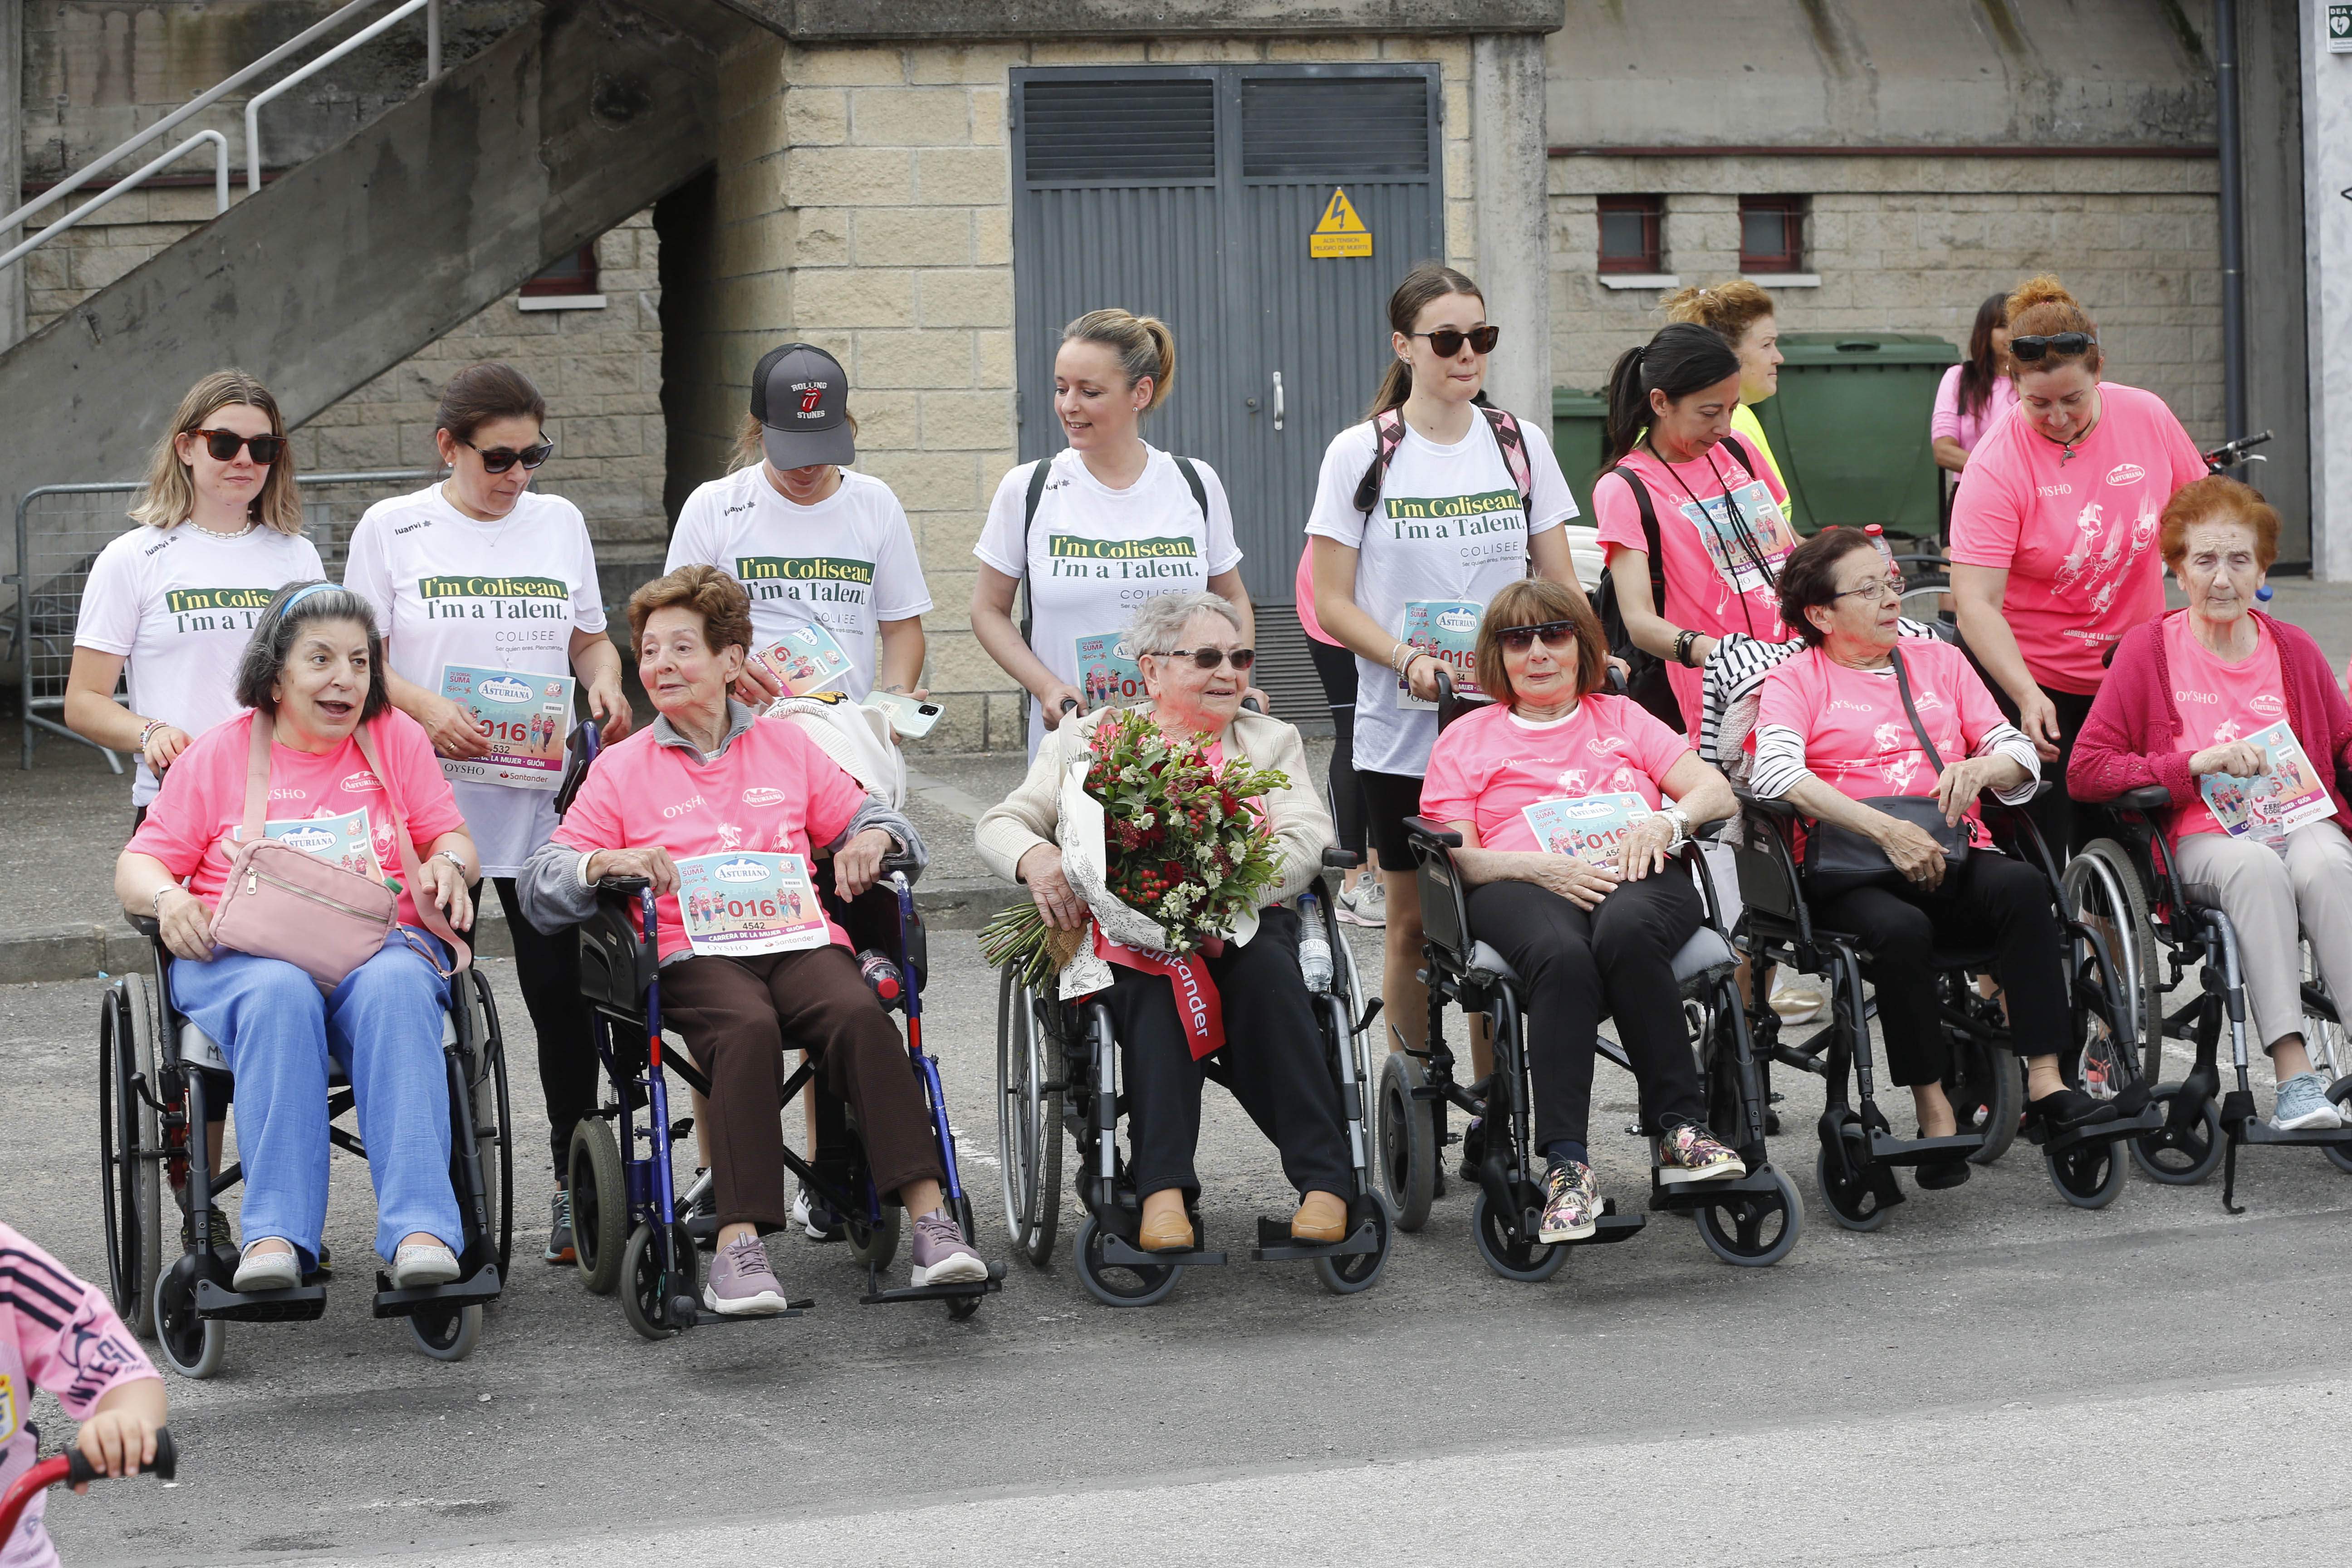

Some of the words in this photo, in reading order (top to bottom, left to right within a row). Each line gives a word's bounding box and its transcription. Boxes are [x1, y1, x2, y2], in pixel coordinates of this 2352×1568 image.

[791, 382, 827, 392] ROLLING
[2110, 470, 2142, 483] ASTURIANA
[1430, 494, 1522, 517] Colisean.
[395, 522, 421, 535] luanvi
[1436, 524, 1449, 538] a
[1094, 540, 1196, 558] Colisean.
[1460, 541, 1519, 557] COLISEE
[784, 559, 871, 583] Colisean.
[1096, 565, 1109, 578] a
[1116, 560, 1198, 578] Talent.
[467, 578, 568, 598] Colisean.
[788, 586, 801, 600] a
[472, 604, 485, 618] a
[490, 600, 568, 620] Talent.
[222, 615, 235, 629] a
[1439, 616, 1475, 627] ASTURIANA
[495, 631, 555, 642] COLISEE
[2063, 629, 2087, 638] CARRERA
[1440, 649, 1476, 669] 016
[481, 684, 529, 699] ASTURIANA
[548, 682, 559, 692] 20
[2176, 691, 2218, 704] OYSHO
[769, 705, 830, 720] PEANUTS
[1827, 700, 1872, 715] OYSHO
[480, 720, 526, 741] 016
[2269, 732, 2280, 742] 20
[490, 745, 510, 754] 532
[445, 763, 485, 775] OYSHO
[510, 773, 548, 783] Santander
[2298, 796, 2312, 804] GIJÓN
[1535, 811, 1556, 820] SUMA
[1570, 807, 1613, 817] ASTURIANA
[2293, 806, 2322, 822] Santander
[349, 819, 360, 830] 20
[682, 868, 705, 877] SUMA
[719, 869, 768, 878] ASTURIANA
[728, 899, 776, 917] 016
[709, 932, 738, 941] CARRERA
[760, 929, 781, 937] MUJER
[786, 924, 805, 932] GIJÓN
[775, 935, 814, 946] Santander
